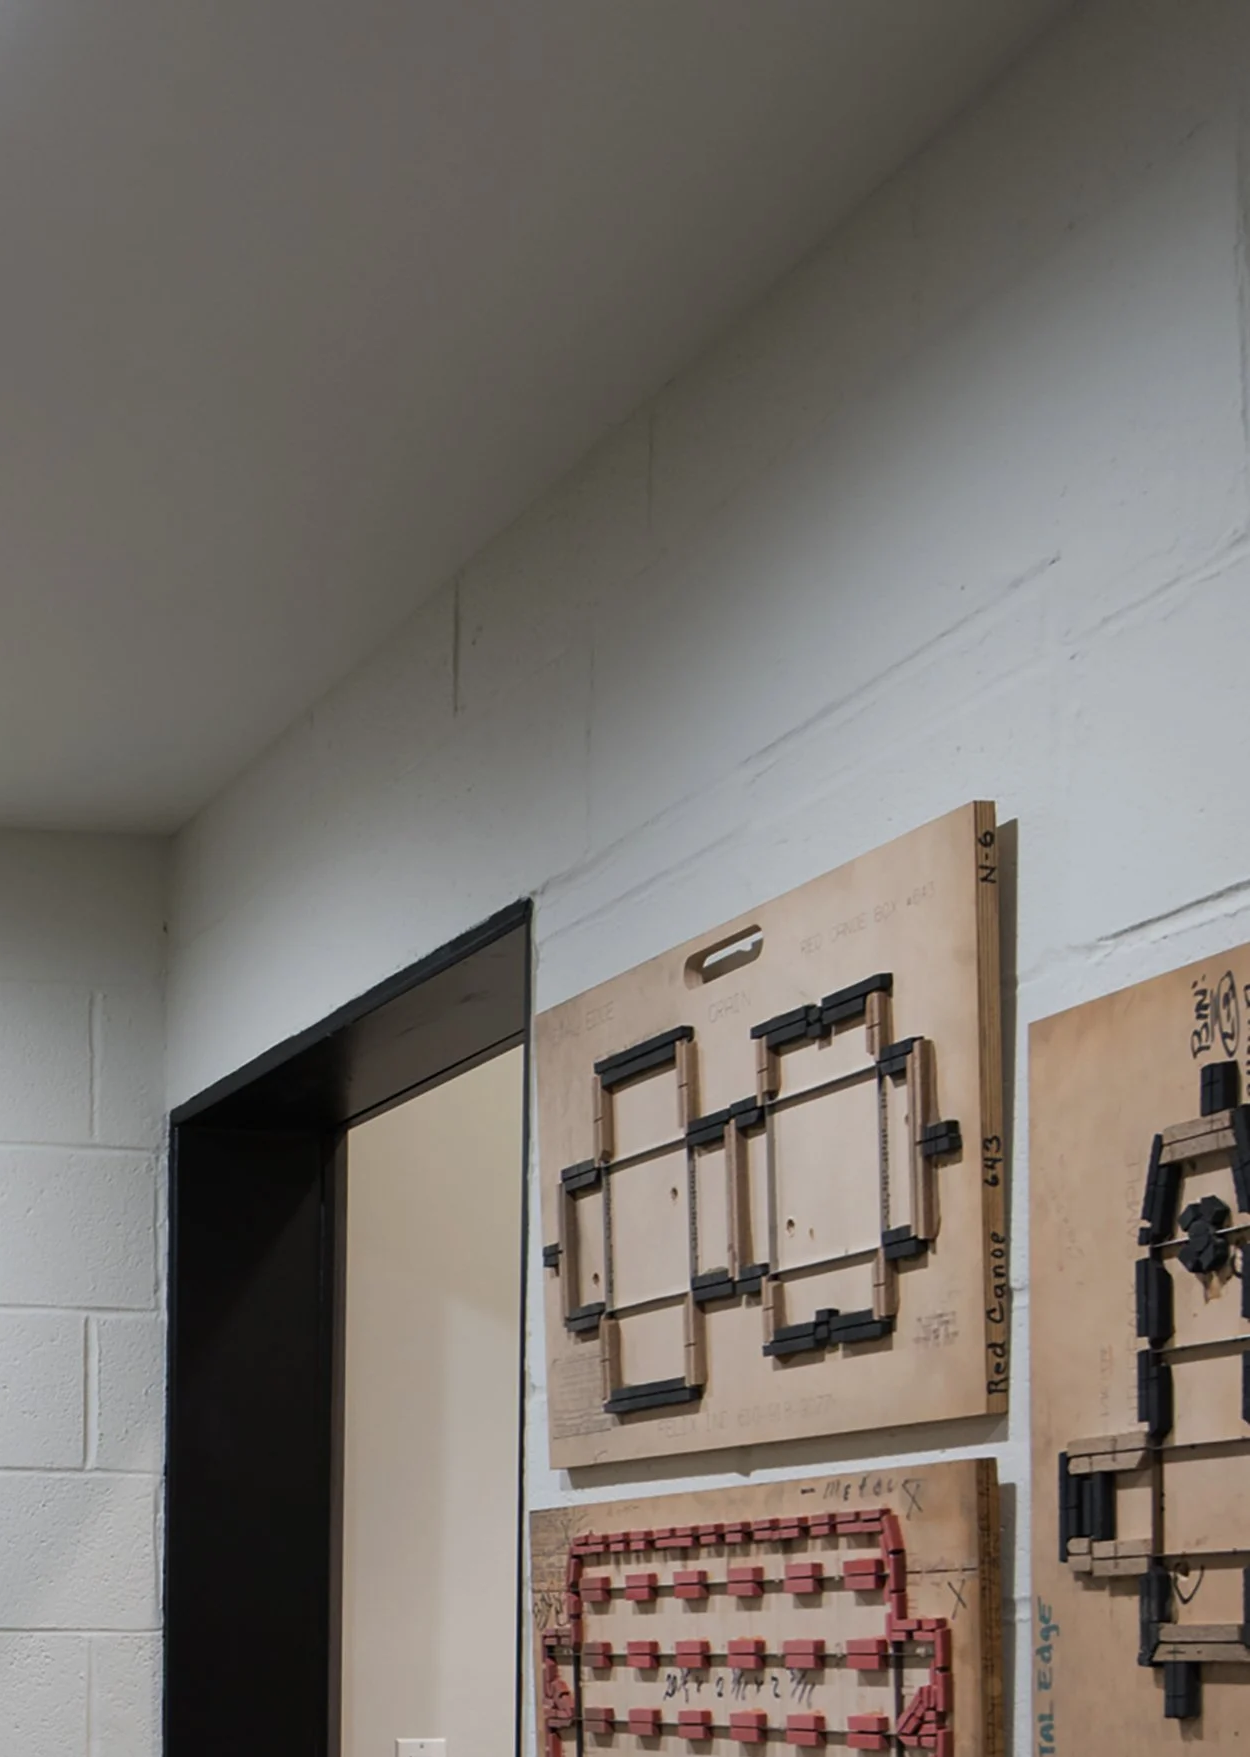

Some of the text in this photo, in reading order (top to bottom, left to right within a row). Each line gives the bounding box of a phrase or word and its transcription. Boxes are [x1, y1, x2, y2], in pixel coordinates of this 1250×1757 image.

[983, 1135, 1008, 1395] Red Canoe 643
